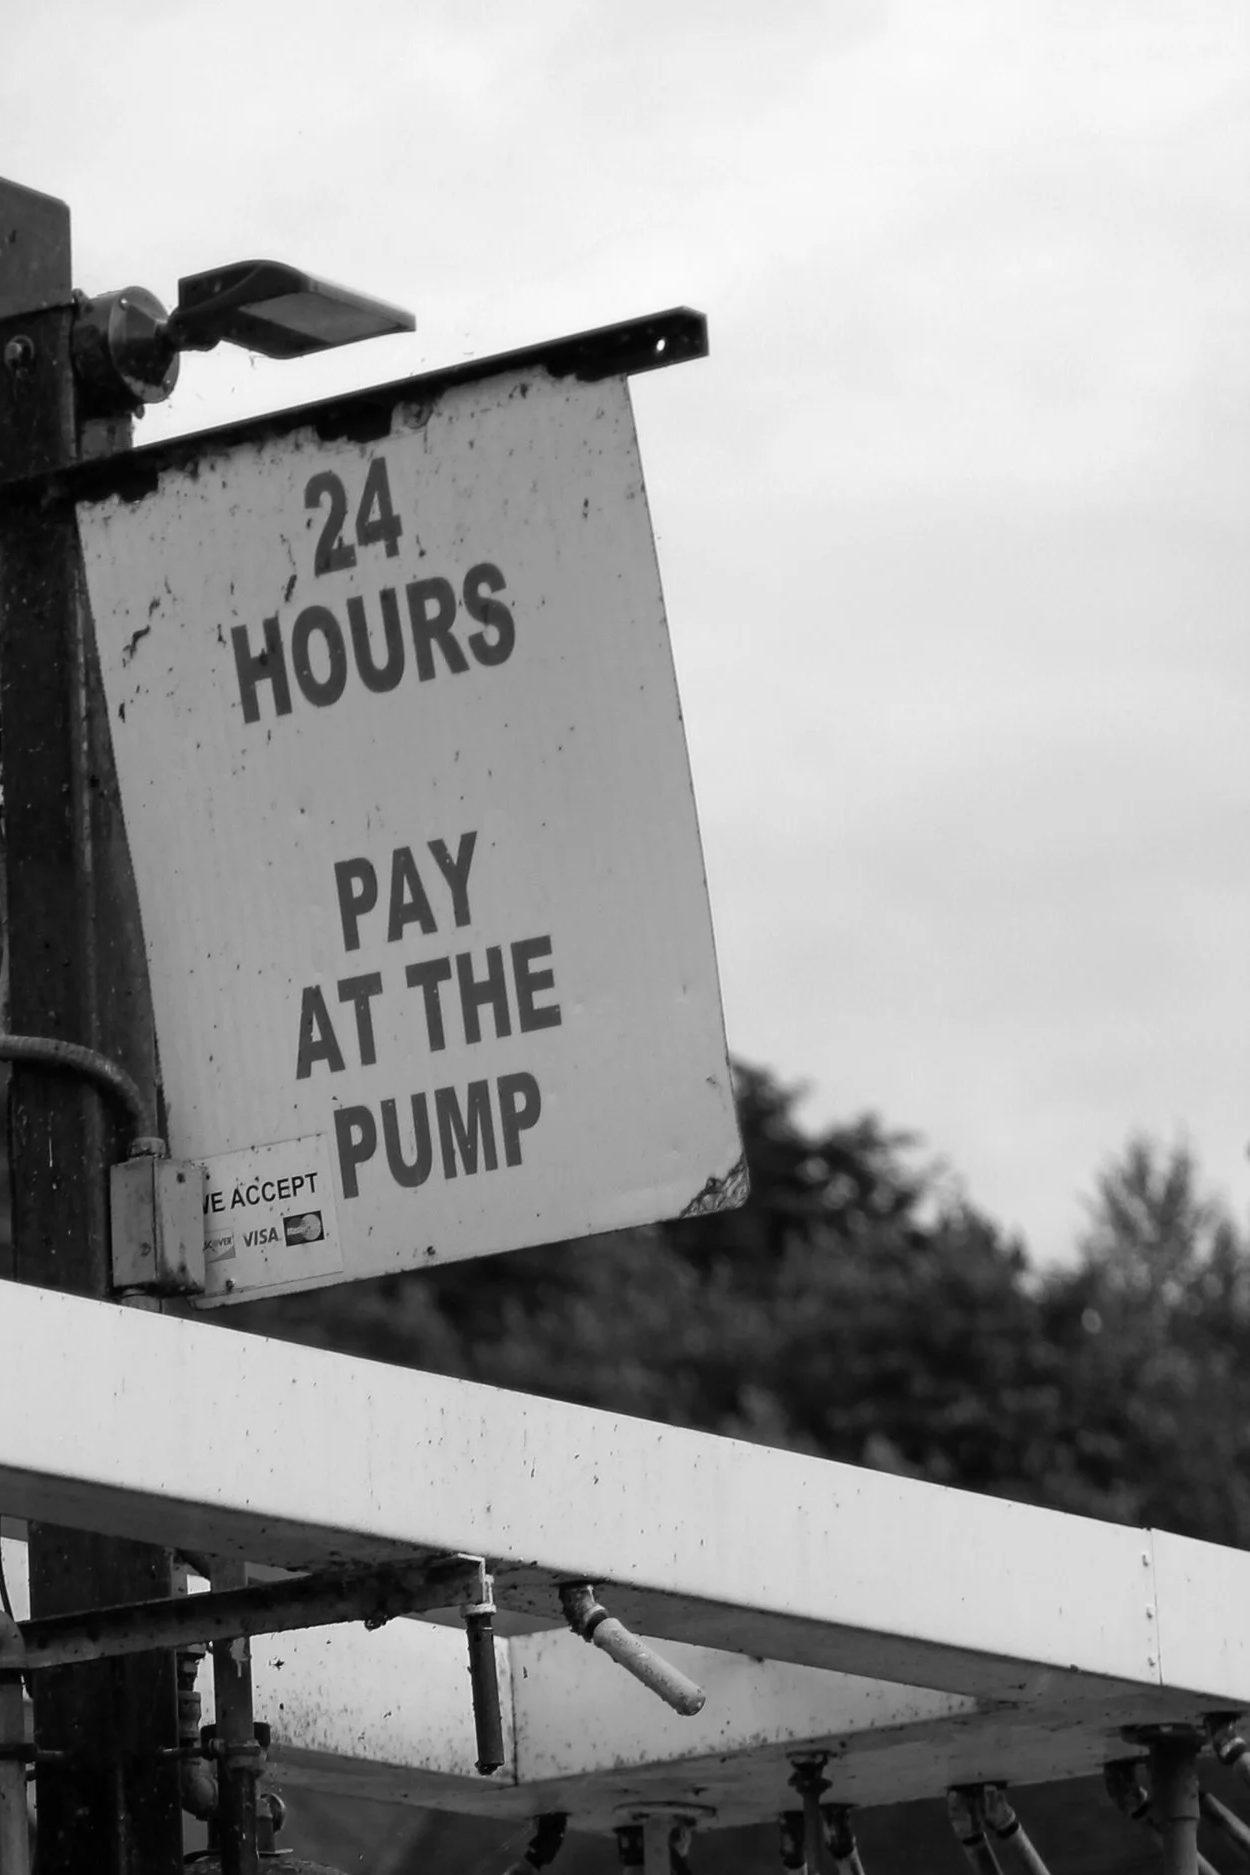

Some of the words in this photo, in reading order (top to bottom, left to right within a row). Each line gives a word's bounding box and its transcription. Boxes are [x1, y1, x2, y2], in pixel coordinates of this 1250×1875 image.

[304, 458, 402, 576] 24
[231, 562, 516, 724] HOURS
[334, 831, 478, 952] PAY
[296, 973, 382, 1080] AT
[406, 935, 562, 1053] THE
[230, 1172, 318, 1210] ACCEPT
[334, 1071, 542, 1199] PUMP
[243, 1227, 279, 1247] VISA
